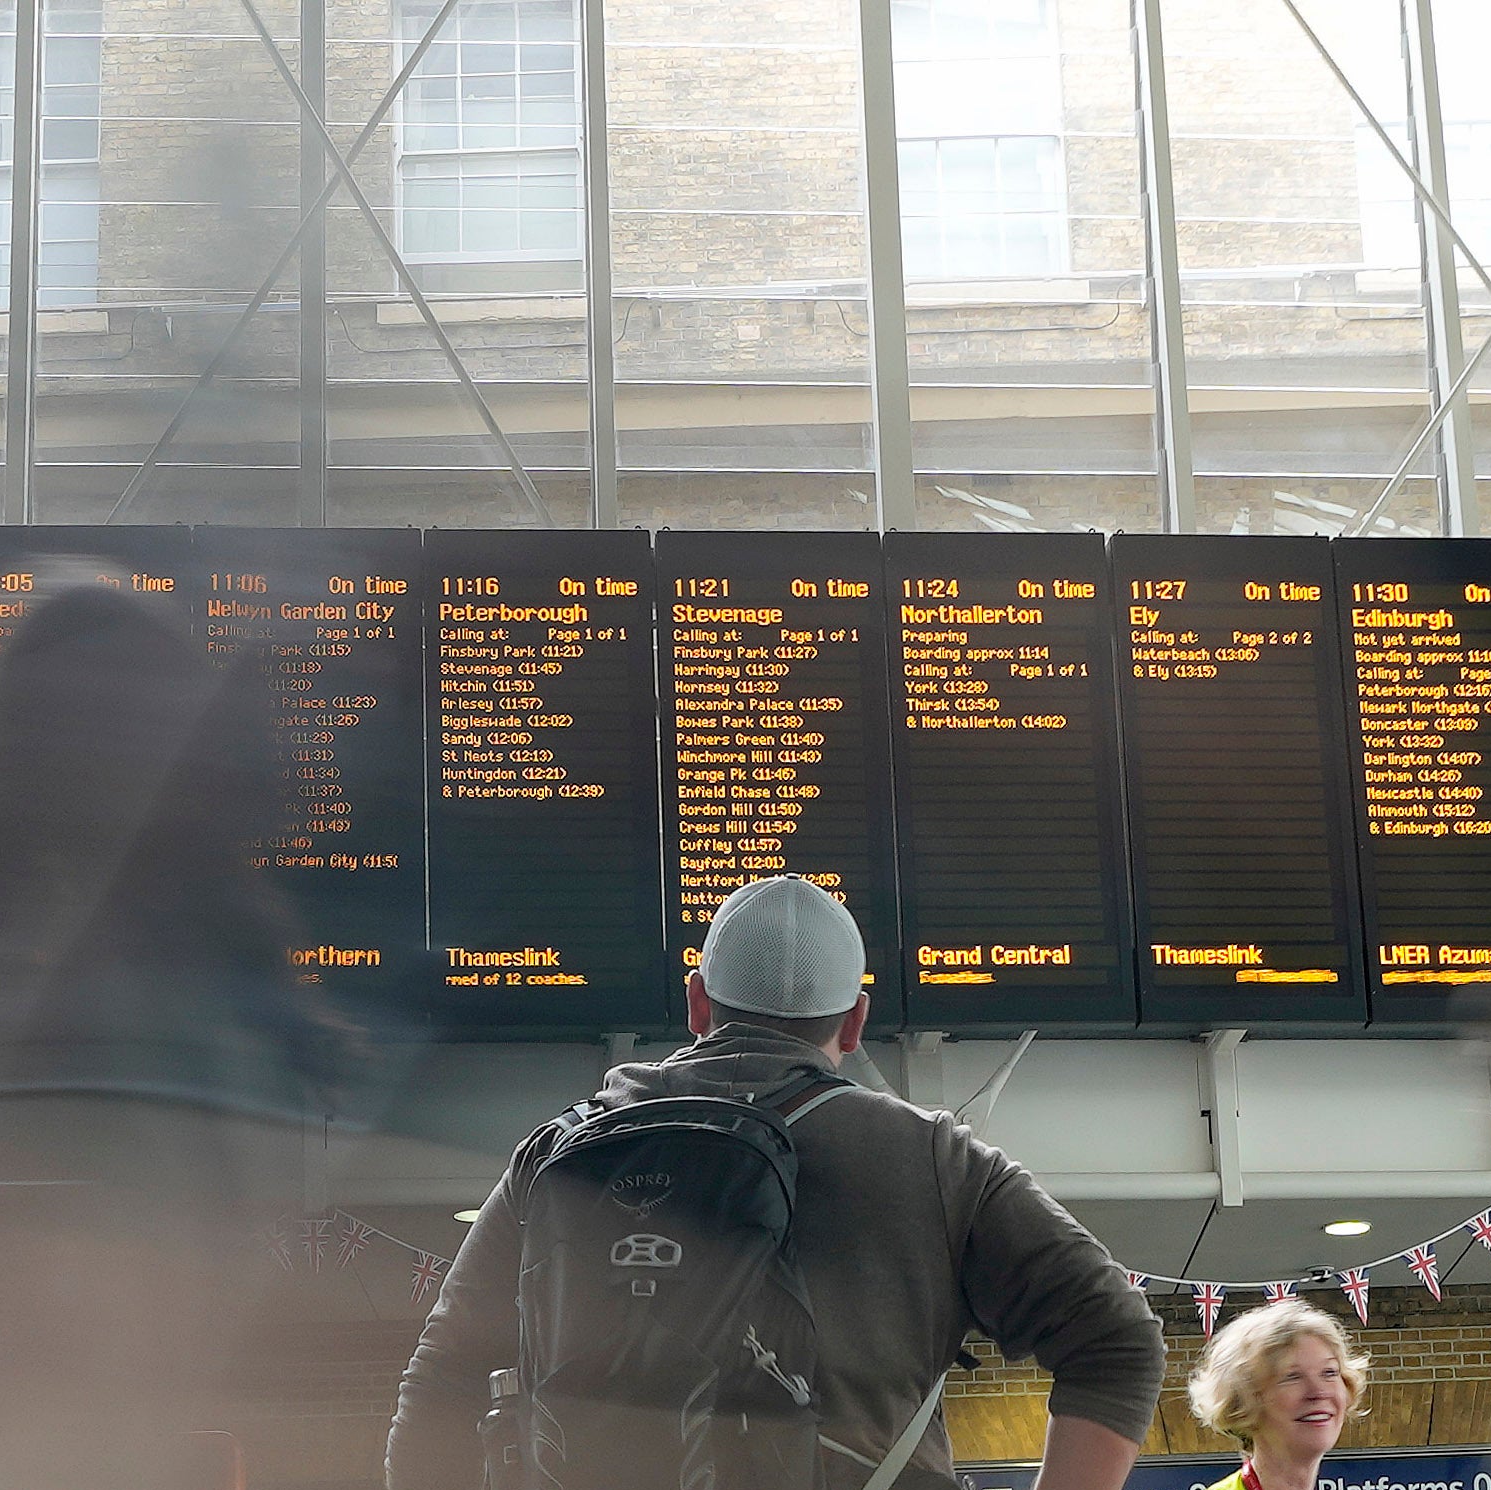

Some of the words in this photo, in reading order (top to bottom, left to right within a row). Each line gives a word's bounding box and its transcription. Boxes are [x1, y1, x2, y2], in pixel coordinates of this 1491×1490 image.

[131, 574, 175, 593] time
[209, 573, 268, 594] 11:06
[329, 577, 355, 593] On
[365, 577, 408, 595] time
[442, 577, 500, 595] 11:16
[558, 577, 586, 595] On
[595, 578, 637, 597] time
[675, 578, 730, 596] 11:21
[790, 580, 818, 597] On
[826, 580, 869, 598] time
[902, 579, 959, 599] 11:24
[1017, 579, 1045, 599] On
[1052, 580, 1095, 599] time
[1130, 580, 1187, 600] 11:27
[1244, 582, 1271, 601] On
[1278, 583, 1321, 601] time
[1352, 583, 1409, 603] 11:30
[1464, 583, 1491, 603] On
[207, 599, 271, 620] Welwyn
[280, 602, 347, 620] Garden
[355, 601, 396, 622] City
[439, 603, 589, 625] Peterborough
[672, 603, 782, 625] Stevenage
[900, 604, 1043, 625] Northallerton
[1129, 605, 1160, 627] Ely
[1352, 608, 1454, 631] Edinburgh
[902, 629, 969, 645] Preparing
[1131, 629, 1176, 646] Calling
[1354, 632, 1376, 646] Not
[1381, 633, 1407, 649] yet
[1410, 634, 1461, 647] arrived
[440, 644, 499, 659] Finsbury
[502, 644, 536, 658] Park
[673, 645, 733, 661] Finsbury
[736, 646, 770, 659] Park
[904, 647, 962, 662] Boarding
[965, 648, 1014, 662] approx
[1019, 647, 1049, 660] 11:14
[440, 679, 488, 693] Hitchin
[491, 679, 535, 693] (11:51)
[675, 681, 731, 697] Hornsey
[736, 679, 780, 694] (11:32)
[906, 681, 938, 694] York
[944, 680, 988, 695] (13:28)
[907, 697, 949, 711] Thirsk
[954, 697, 1000, 712] (13:54)
[441, 733, 483, 748] Sandy
[486, 731, 533, 746] (12:06)
[446, 947, 559, 967] Thameslink
[917, 946, 983, 966] Grand
[990, 946, 1071, 965] Central
[1152, 944, 1262, 965] Thameslink
[1379, 945, 1431, 965] LNER
[611, 1173, 670, 1192] OSPREY
